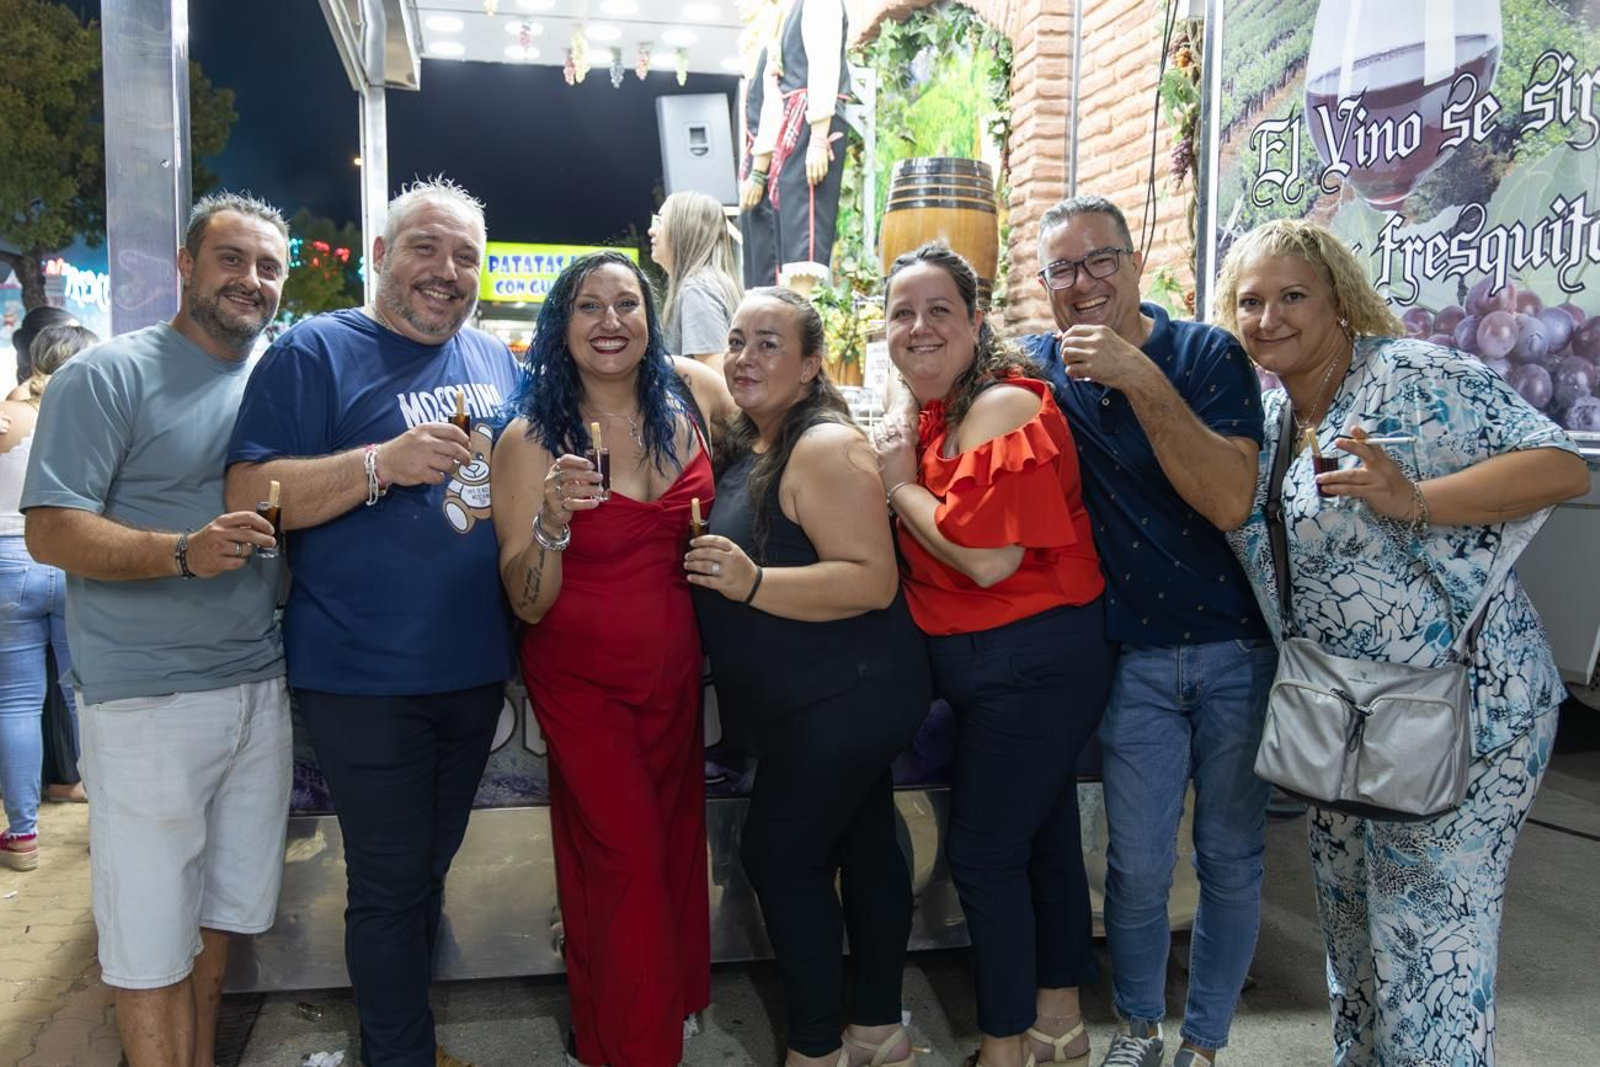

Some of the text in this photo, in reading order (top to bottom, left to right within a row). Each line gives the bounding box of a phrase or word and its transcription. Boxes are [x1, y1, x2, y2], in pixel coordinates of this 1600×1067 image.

[1251, 103, 1304, 207] El
[1314, 87, 1422, 194] Vino
[1441, 73, 1502, 152] se
[489, 255, 563, 273] PATATAS
[496, 279, 525, 295] CON
[397, 383, 504, 429] MOSCHIN
